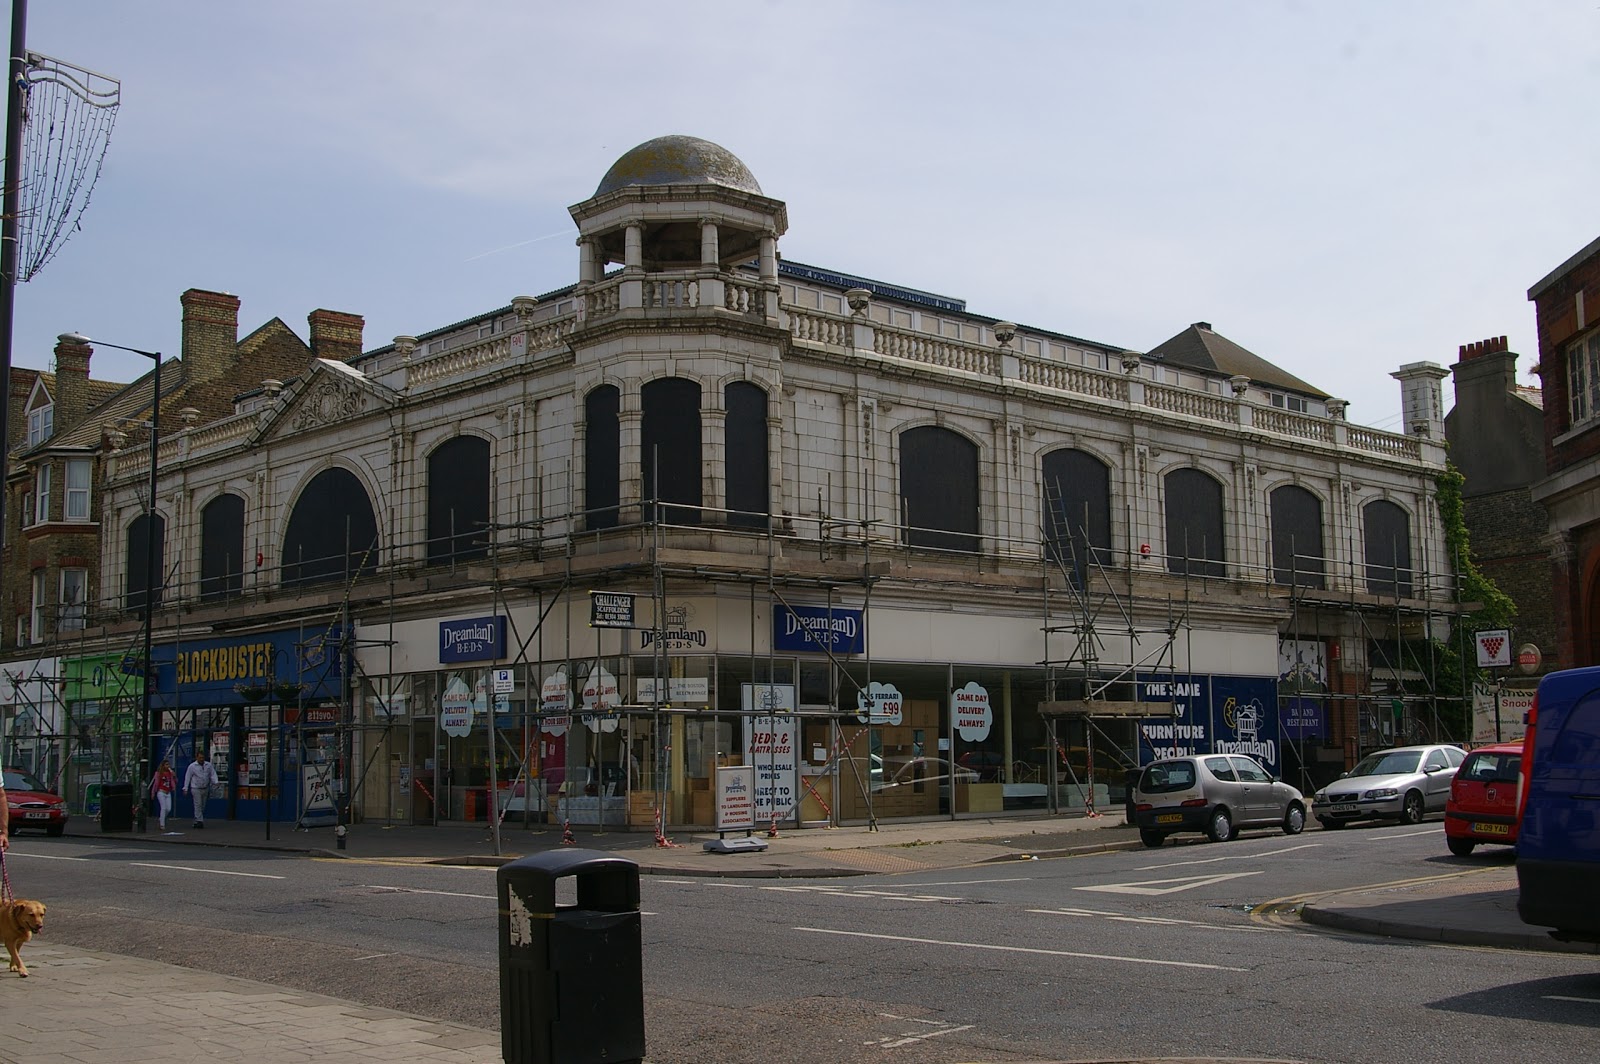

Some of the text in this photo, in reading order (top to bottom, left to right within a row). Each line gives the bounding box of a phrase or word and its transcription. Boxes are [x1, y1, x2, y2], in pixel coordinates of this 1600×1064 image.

[595, 594, 631, 607] CHALLENGER
[596, 606, 630, 615] SCAFFOLDING
[500, 671, 507, 680] P
[1145, 683, 1201, 697] THE SAME
[957, 693, 988, 703] SAME DAY
[445, 706, 467, 715] DELIVERY
[883, 701, 899, 715] £99
[958, 706, 985, 716] DELIVERY
[1303, 708, 1314, 717] AND
[958, 719, 985, 728] ALWAYS!
[1286, 718, 1319, 727] RESTURANT
[1143, 725, 1205, 740] FURNTURE
[781, 733, 789, 744] &
[749, 745, 791, 754] MATTRSSES
[779, 787, 790, 796] TO
[1475, 823, 1493, 832] GL09
